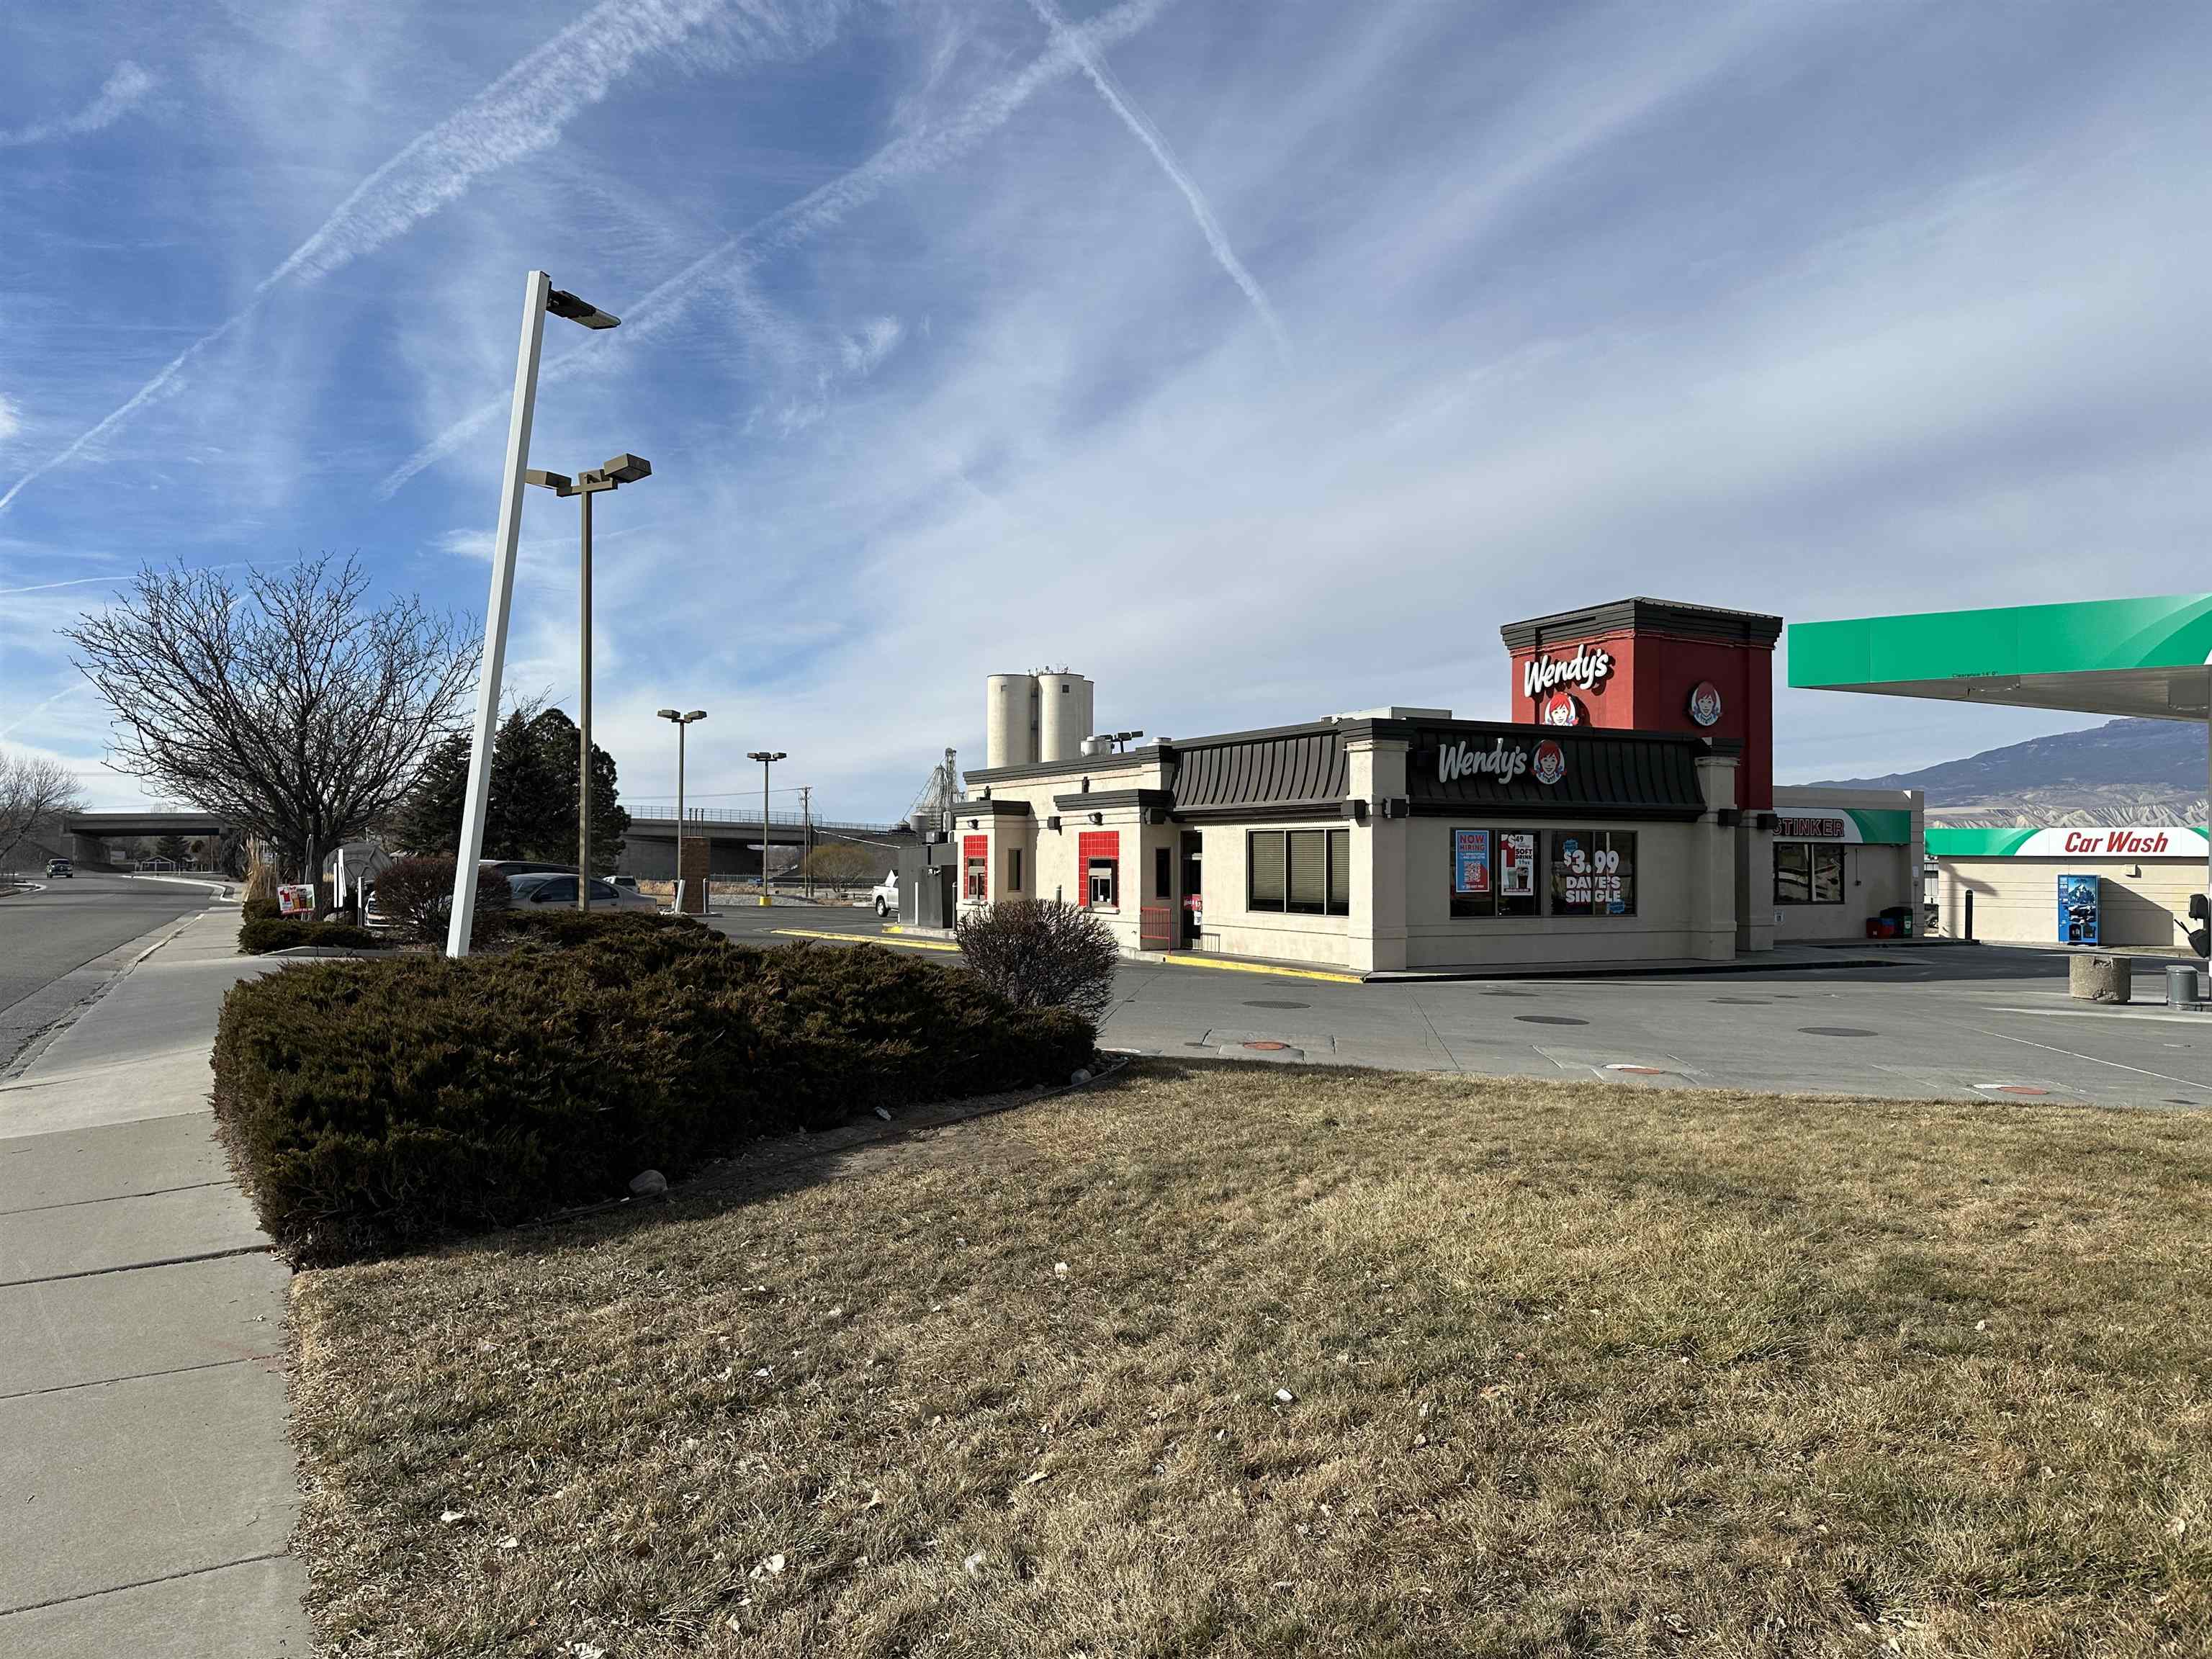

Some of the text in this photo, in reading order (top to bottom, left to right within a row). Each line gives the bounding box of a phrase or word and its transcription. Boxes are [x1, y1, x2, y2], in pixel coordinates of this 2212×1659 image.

[1524, 644, 1609, 698] Wendy's
[1439, 737, 1527, 784] Wendy's
[1460, 835, 1485, 844] NOW
[2064, 831, 2169, 853] Car Wash
[1564, 850, 1619, 873] $3.99
[1566, 876, 1621, 889] DAVE'S
[1565, 890, 1621, 903] SINGLE
